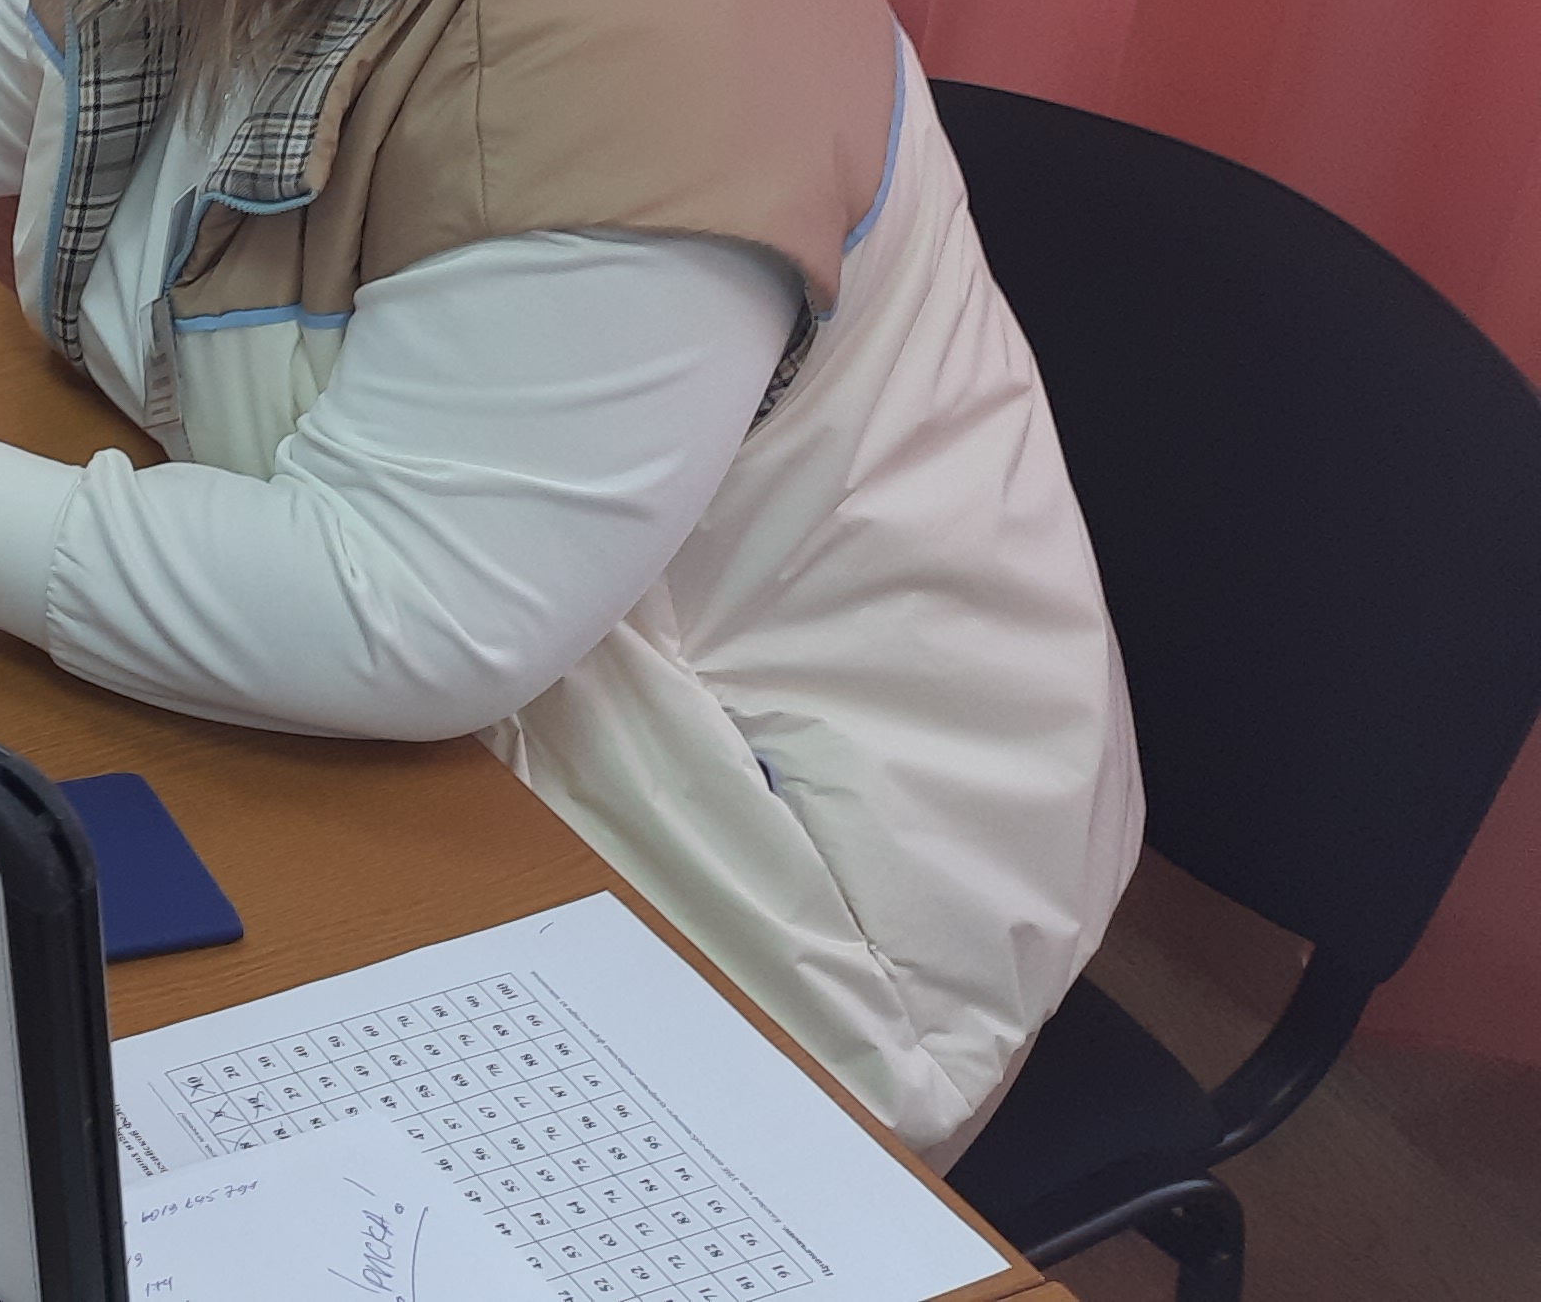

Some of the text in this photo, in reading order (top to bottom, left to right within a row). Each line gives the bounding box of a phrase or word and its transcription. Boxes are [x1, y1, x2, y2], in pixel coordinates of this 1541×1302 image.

[327, 1035, 346, 1048] 50
[292, 1045, 310, 1059] 40
[257, 1055, 277, 1070] 30
[222, 1065, 242, 1080] 20
[353, 1065, 370, 1077] 49
[318, 1076, 338, 1089] 39
[282, 1086, 302, 1101] 29
[379, 1095, 398, 1109] 48
[272, 1126, 293, 1141] 18
[406, 1128, 425, 1141] 47
[496, 982, 792, 1279] 91 92 93 94 95 96 97 98 99 100
[396, 1015, 651, 1281] 62 63 64 65 66 67 68 69 70
[466, 995, 756, 1291] 81 82 83 84 85 86 87 88 89 90
[362, 1025, 615, 1293] 52 53 54 55 56 57 58 59 60
[430, 1005, 718, 1302] 71 72 73 74 75 76 77 78 79 80
[434, 1158, 454, 1172] 46
[463, 1190, 482, 1203] 45
[494, 1222, 513, 1237] 44
